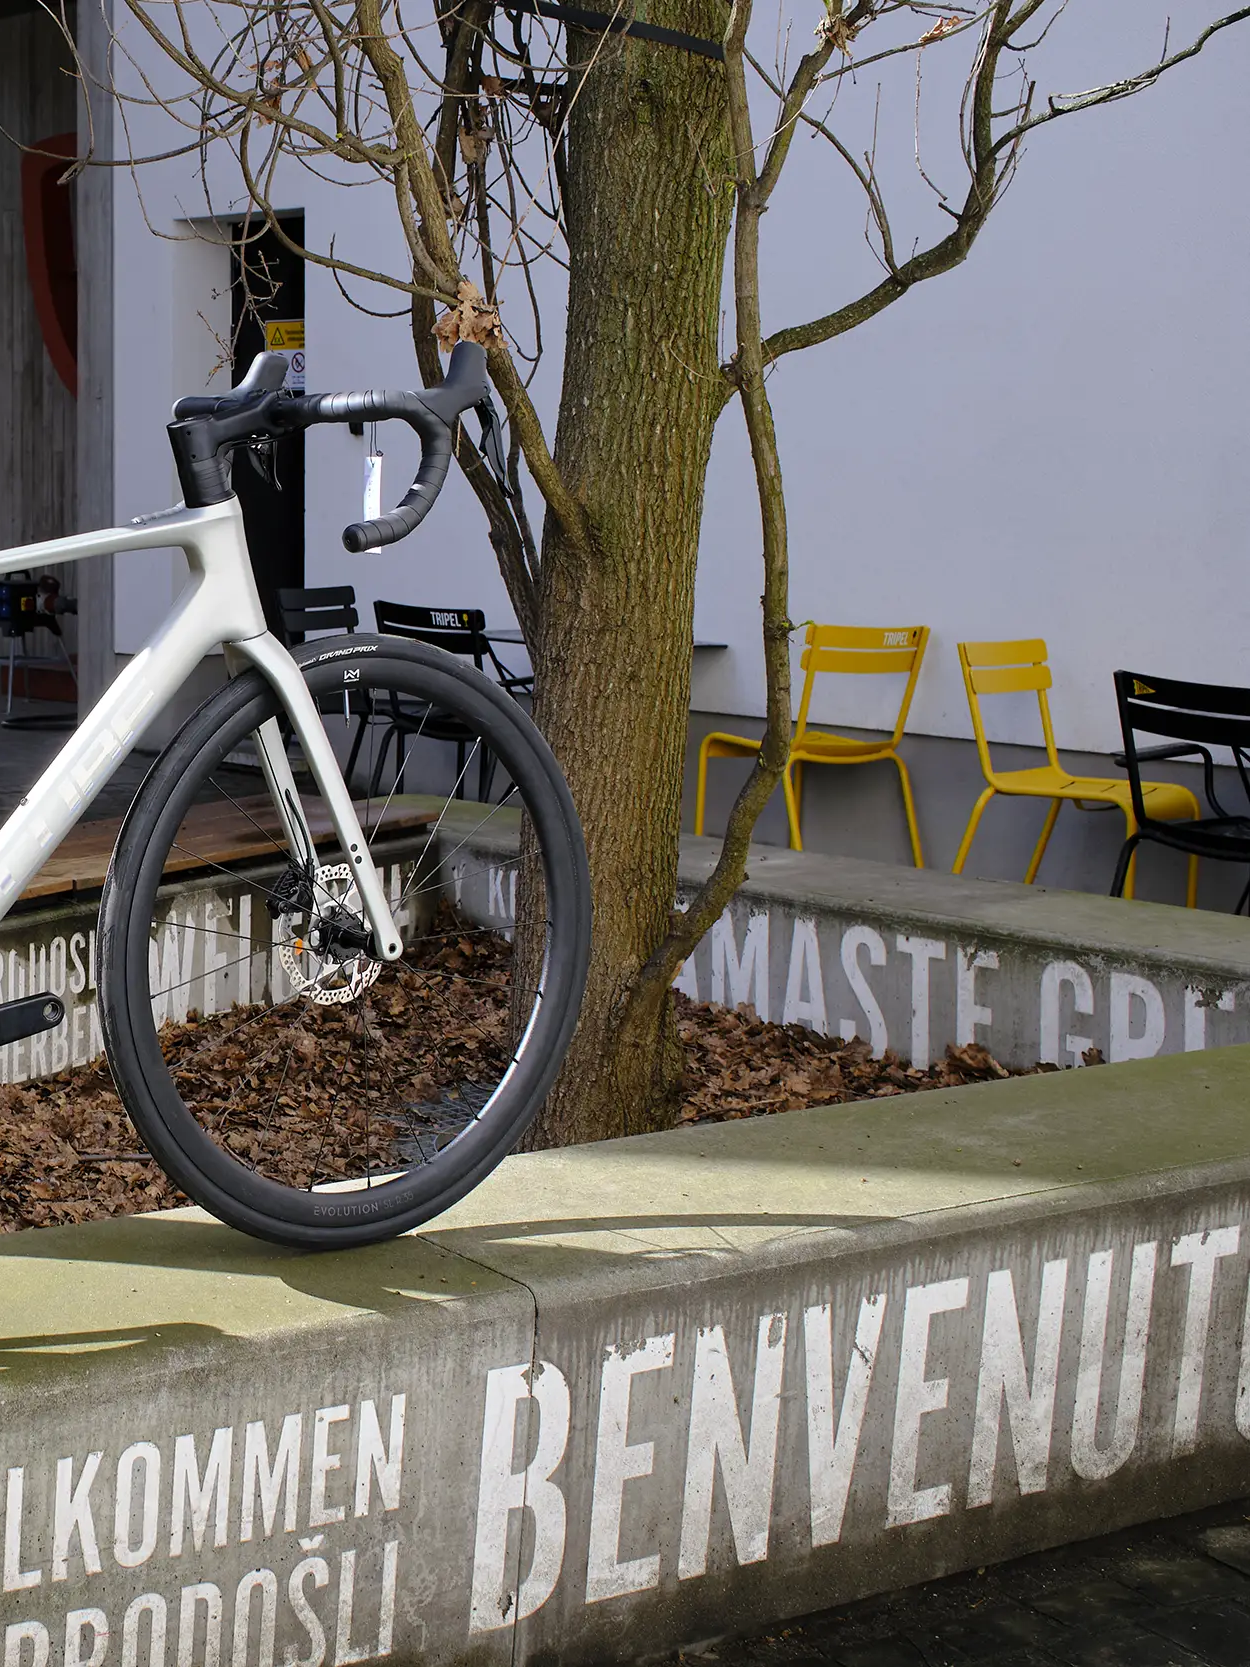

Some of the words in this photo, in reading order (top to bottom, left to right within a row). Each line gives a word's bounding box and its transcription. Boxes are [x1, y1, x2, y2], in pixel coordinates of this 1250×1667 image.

[430, 611, 462, 627] TRIPEL
[883, 631, 909, 646] TRIPEL
[318, 648, 354, 661] GRAND
[352, 645, 378, 653] PRIX
[672, 898, 1000, 1071] MASTE
[314, 1202, 380, 1217] EVOLUTION
[469, 1224, 1250, 1636] BENVENUT
